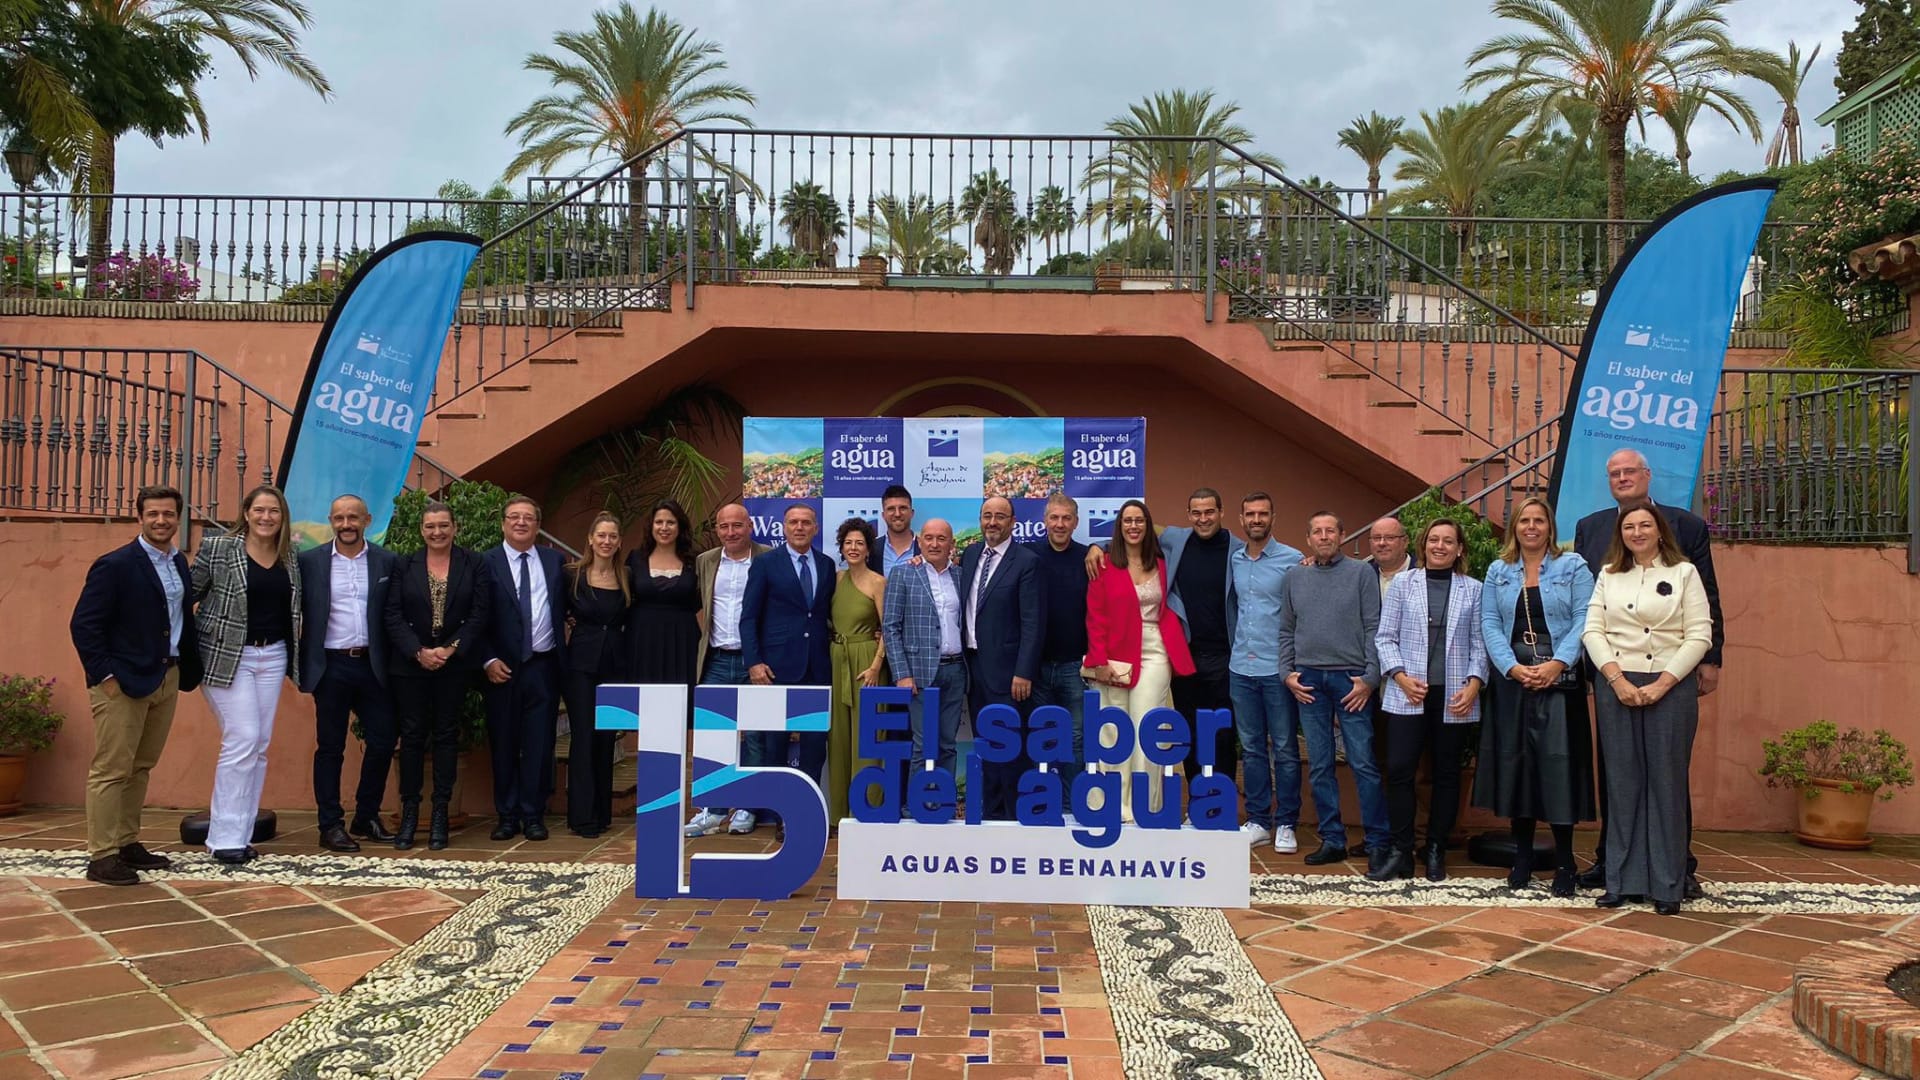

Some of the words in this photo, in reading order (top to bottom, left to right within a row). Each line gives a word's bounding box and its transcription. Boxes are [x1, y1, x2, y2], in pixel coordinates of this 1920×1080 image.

[340, 362, 354, 375] El
[355, 370, 393, 386] saber
[395, 379, 413, 394] del
[1607, 361, 1622, 375] El
[1624, 365, 1668, 381] saber
[1671, 370, 1694, 385] del
[316, 382, 414, 433] agua
[1582, 380, 1698, 430] agua
[316, 420, 324, 428] 15
[840, 434, 848, 443] El
[850, 434, 874, 443] saber
[875, 434, 888, 443] del
[1081, 434, 1088, 442] El
[1090, 434, 1115, 442] saber
[1116, 434, 1129, 442] del
[1584, 429, 1592, 437] 15
[1593, 430, 1612, 439] años
[1614, 433, 1654, 445] creciendo
[1655, 438, 1686, 450] contigo
[831, 443, 895, 474] agua
[1072, 443, 1137, 474] agua
[858, 687, 941, 760] El
[975, 689, 1233, 766] saber
[595, 684, 832, 900] 15
[848, 751, 982, 825] del
[1015, 768, 1241, 849] agua
[881, 854, 980, 874] AGUAS
[990, 856, 1028, 876] DE
[1039, 857, 1208, 880] BENAHAVÍS
